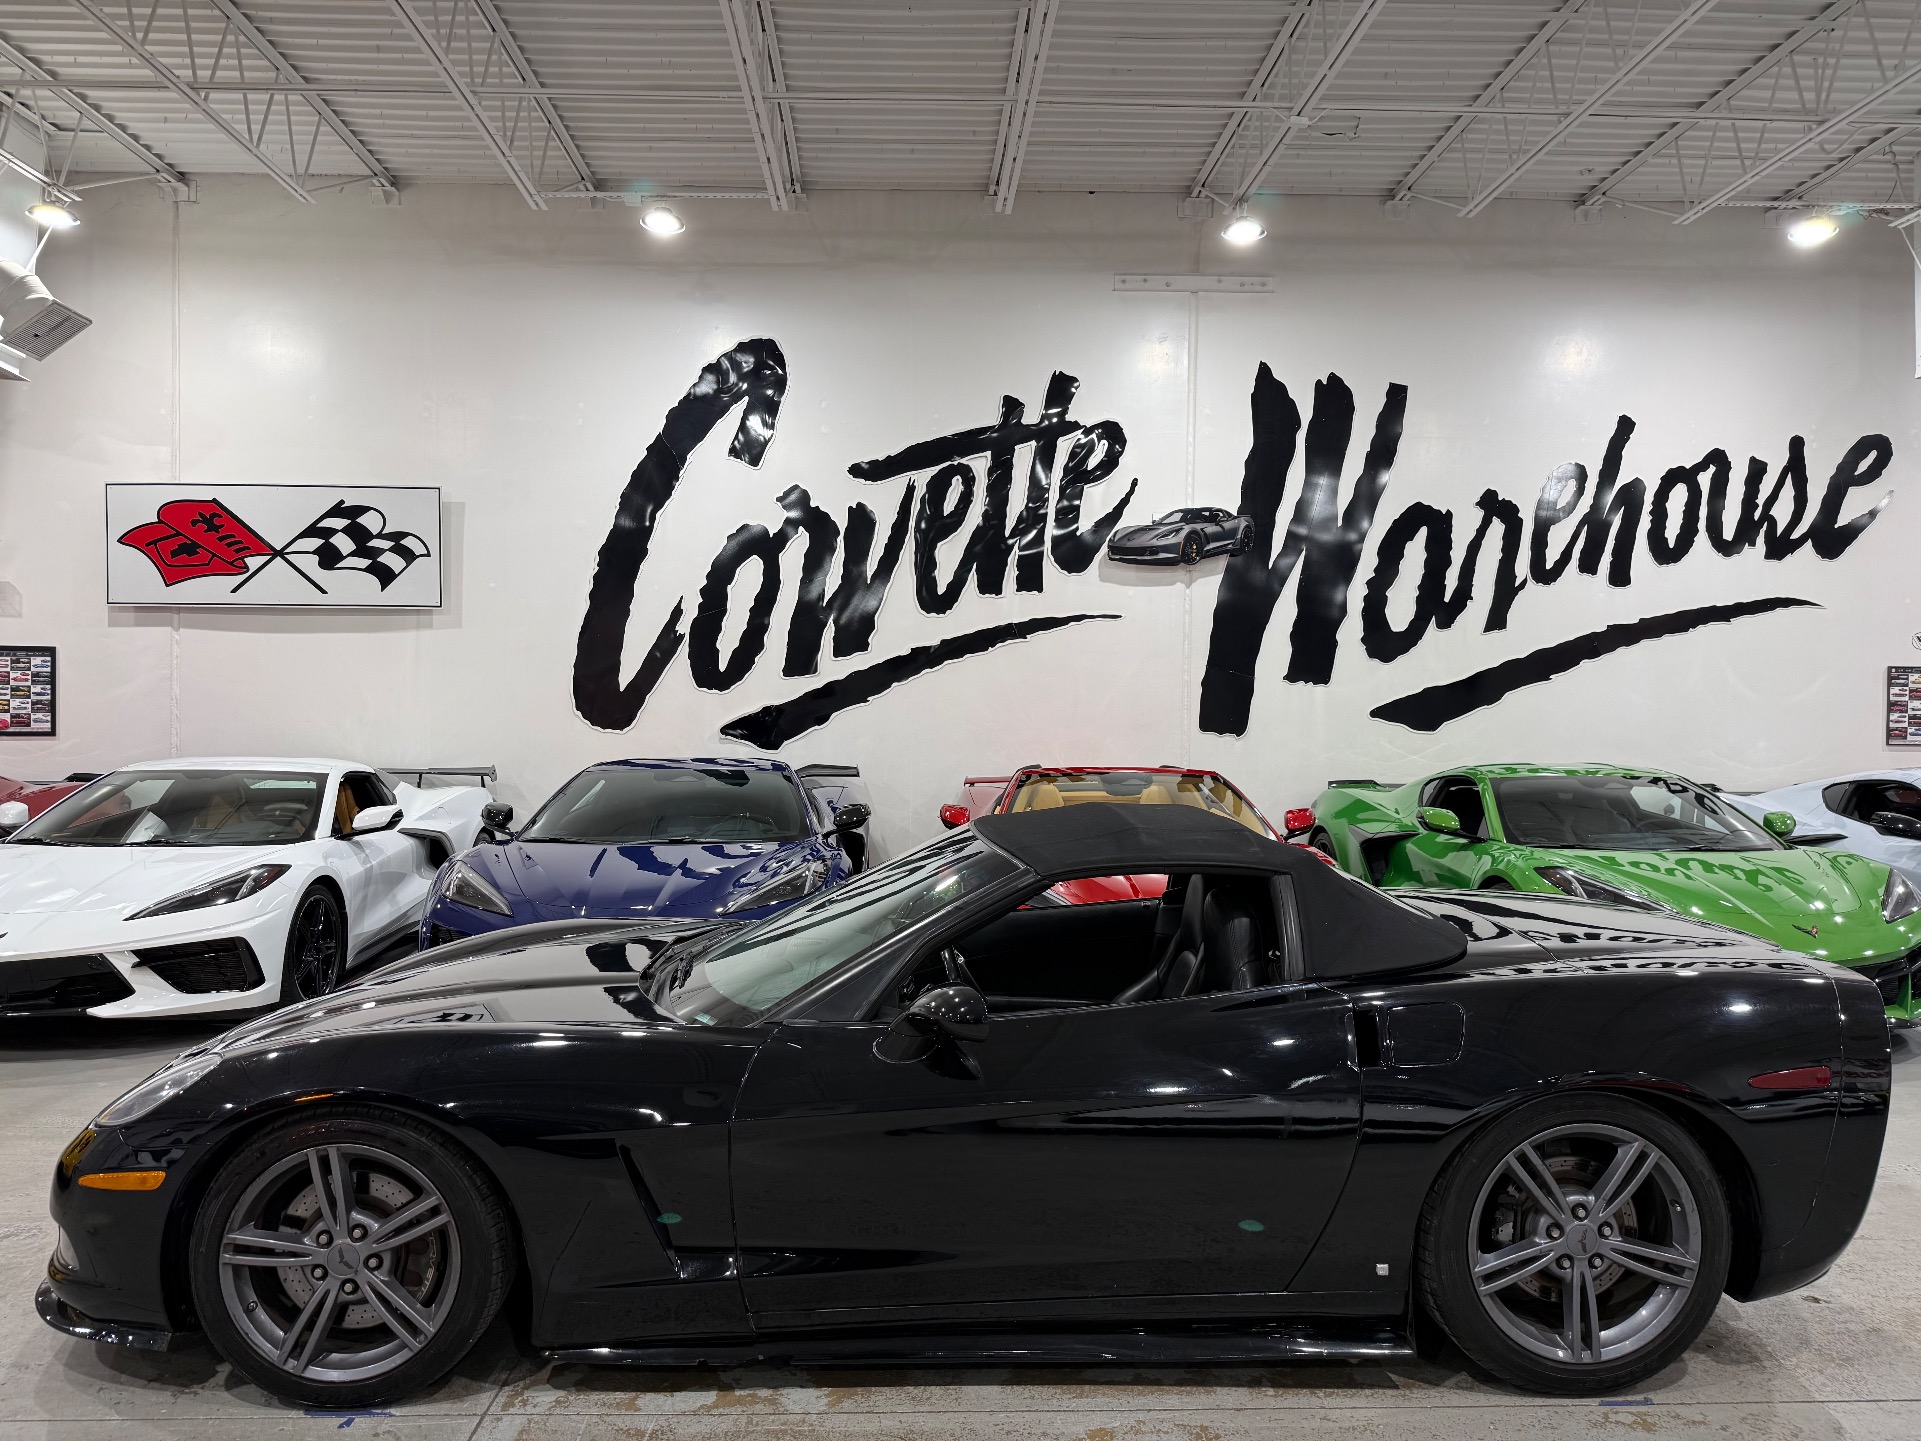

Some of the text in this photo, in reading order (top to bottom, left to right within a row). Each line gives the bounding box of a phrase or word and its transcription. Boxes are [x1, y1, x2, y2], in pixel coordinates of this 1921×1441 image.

[572, 337, 1894, 737] Corvette Warehouse
[415, 1231, 437, 1303] ORVETTE
